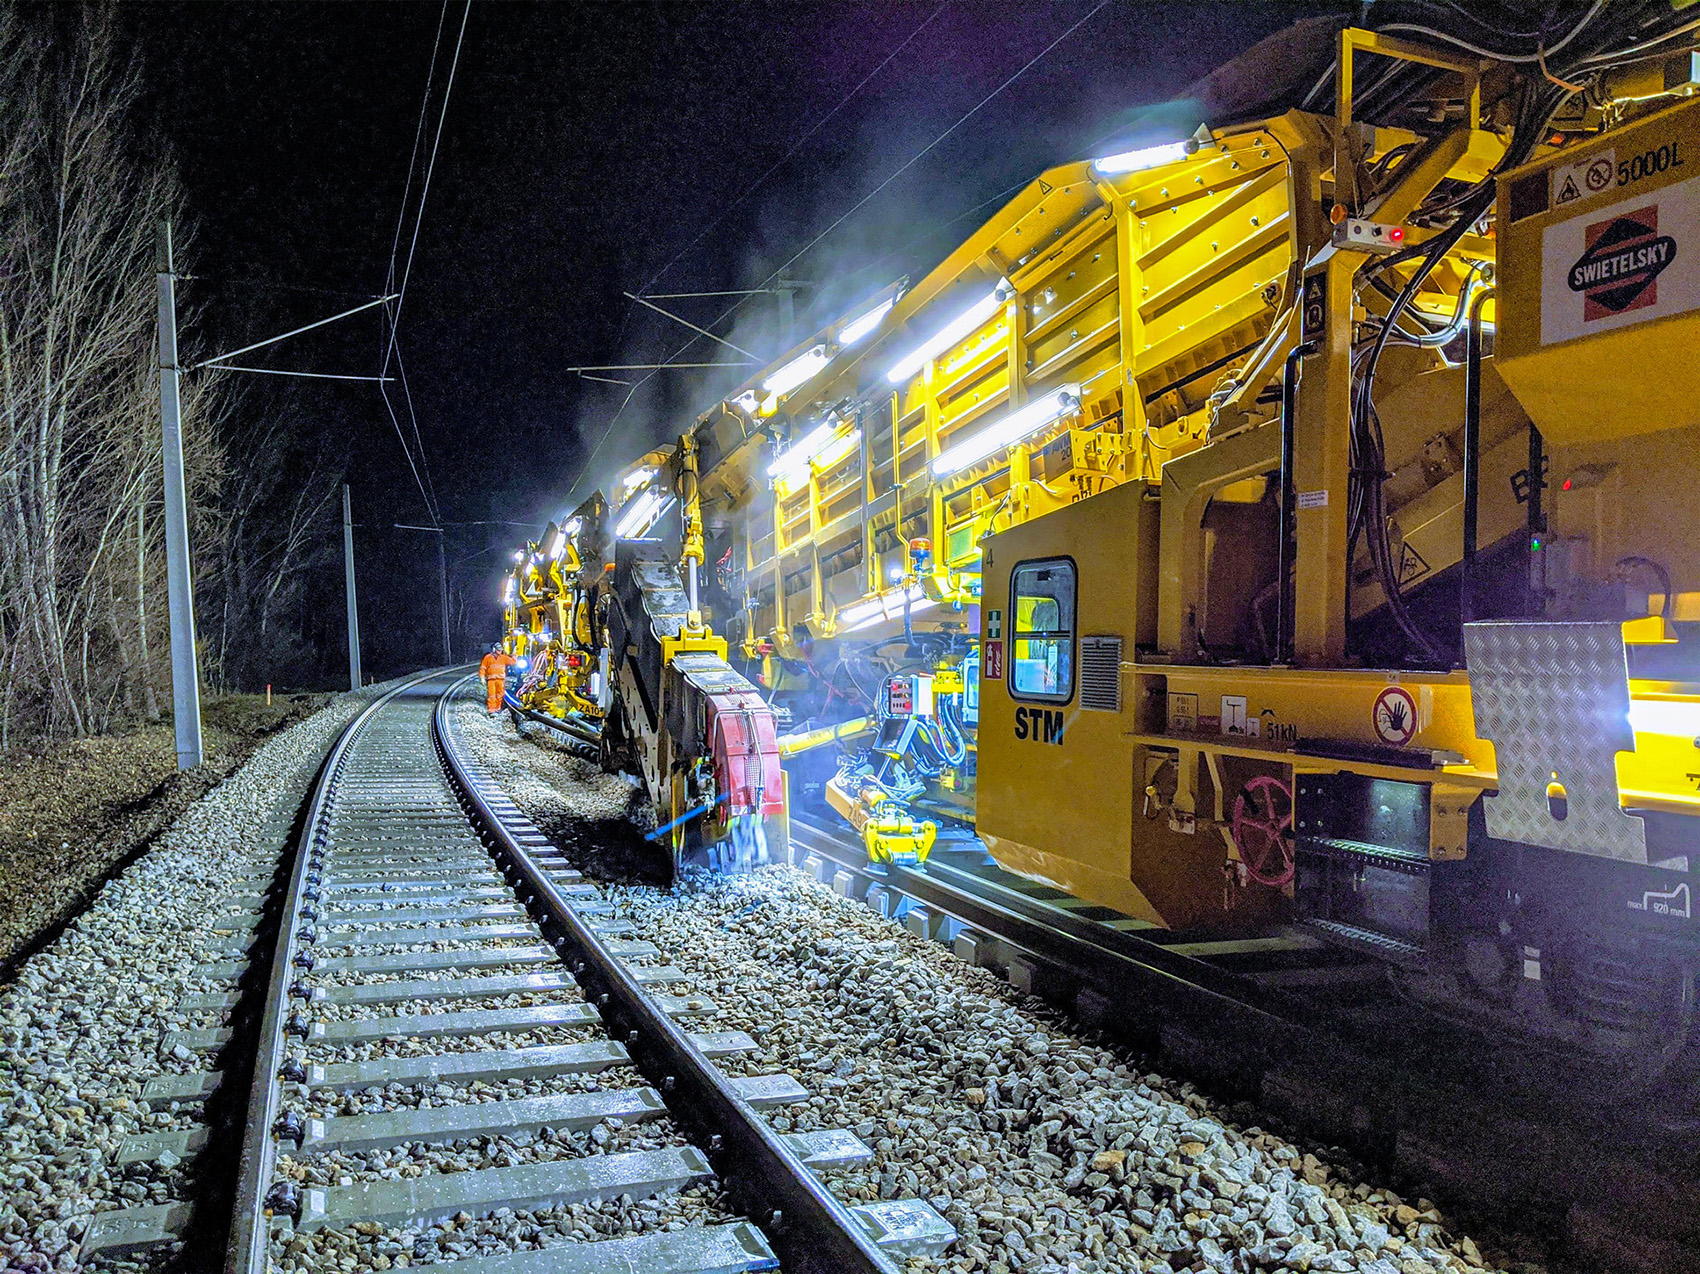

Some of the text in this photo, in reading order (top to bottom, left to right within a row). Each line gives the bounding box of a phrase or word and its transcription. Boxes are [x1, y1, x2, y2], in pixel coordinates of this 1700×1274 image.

[1616, 142, 1684, 187] 5000L
[1574, 242, 1668, 286] SWIETELSKY
[986, 548, 994, 568] 4
[579, 704, 600, 716] ZA10
[1014, 706, 1064, 746] STM
[1267, 722, 1297, 741] 51kN
[1653, 902, 1669, 915] 920
[1670, 908, 1685, 917] mm
